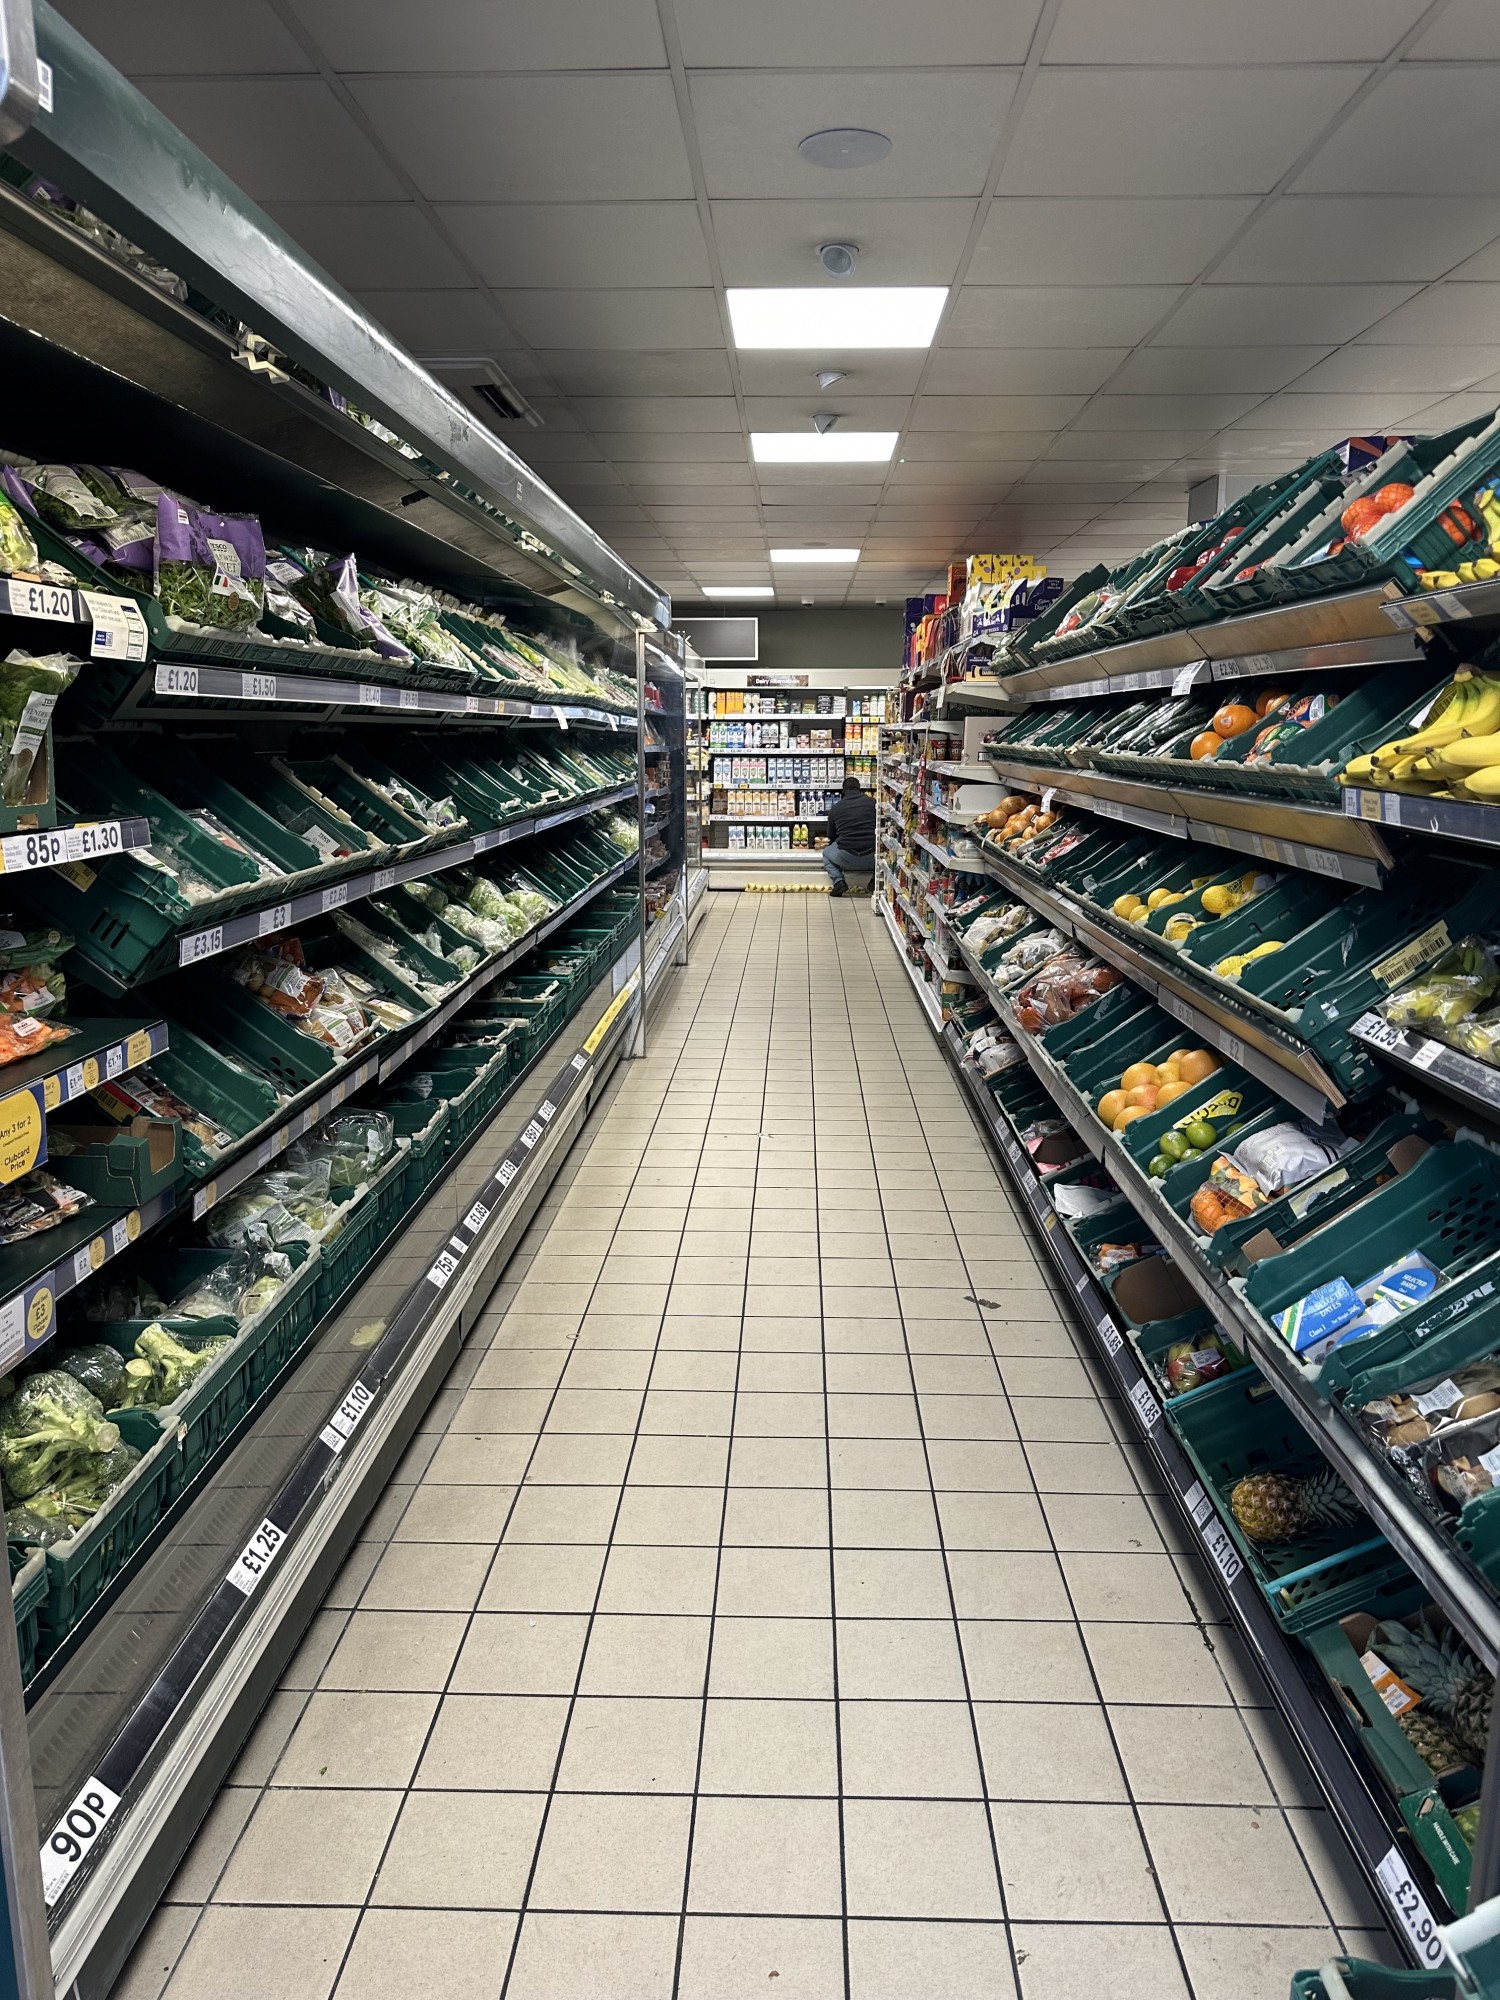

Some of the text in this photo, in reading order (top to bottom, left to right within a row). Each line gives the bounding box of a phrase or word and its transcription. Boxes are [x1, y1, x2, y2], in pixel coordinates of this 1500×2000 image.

[28, 587, 70, 617] £1.20
[168, 669, 197, 692] £1.20
[1219, 663, 1239, 676] £2.90
[252, 677, 275, 696] £1.50
[26, 834, 60, 865] 85p
[82, 826, 118, 853] £1.30
[1315, 853, 1340, 873] £2.90
[329, 884, 348, 905] £2.60
[273, 907, 286, 929] £3
[193, 929, 221, 957] £3.15
[1229, 1039, 1240, 1061] £2
[0, 1128, 10, 1139] Any
[12, 1123, 16, 1133] 3
[17, 1119, 26, 1130] for
[27, 1116, 31, 1126] 2
[4, 1146, 30, 1166] Clubcard
[10, 1159, 26, 1172] Price
[469, 1203, 488, 1225] £1.85
[80, 1258, 87, 1270] £2
[434, 1256, 454, 1277] 75p
[1400, 1280, 1418, 1290] DATES
[1402, 1274, 1428, 1287] SELECTED
[1314, 1287, 1348, 1310] SELECTED
[1320, 1300, 1342, 1317] DATES
[35, 1304, 46, 1321] £3
[1103, 1325, 1122, 1353] £1.85
[1308, 1326, 1323, 1338] Class
[341, 1385, 369, 1422] £1.10
[1137, 1391, 1160, 1423] £1.85
[241, 1523, 281, 1575] £1.25
[1211, 1533, 1240, 1578] £1.10
[50, 1792, 106, 1863] 90p
[1432, 1821, 1461, 1866] HANDLE WITH CARE
[1395, 1880, 1442, 1961] £2.90
